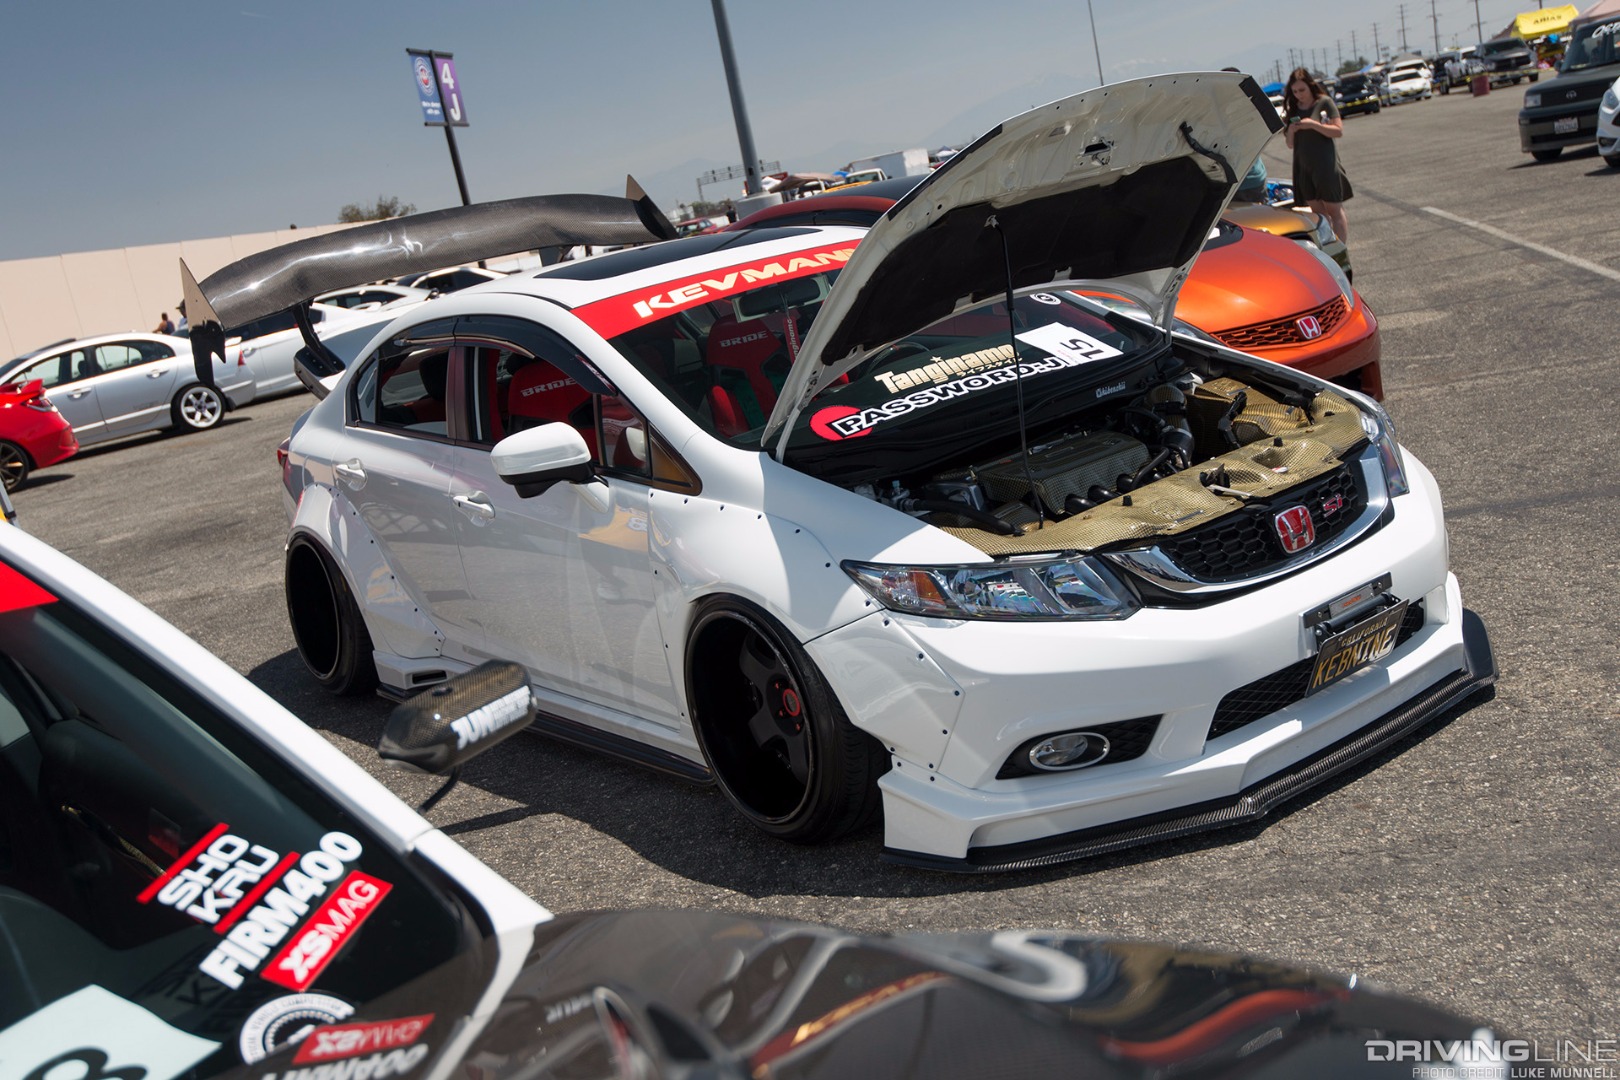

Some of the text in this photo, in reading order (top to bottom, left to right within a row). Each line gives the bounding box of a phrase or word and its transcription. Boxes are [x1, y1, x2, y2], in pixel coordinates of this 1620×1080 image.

[442, 63, 455, 90] 4
[450, 93, 461, 121] J
[719, 331, 769, 348] BRIDE
[521, 377, 577, 397] BRIDE
[1341, 616, 1389, 647] CALIFORNIA
[1312, 623, 1398, 689] KEBNINE
[157, 834, 250, 911] SHO
[199, 831, 363, 990] FIRM400
[279, 879, 380, 983] XSMAG
